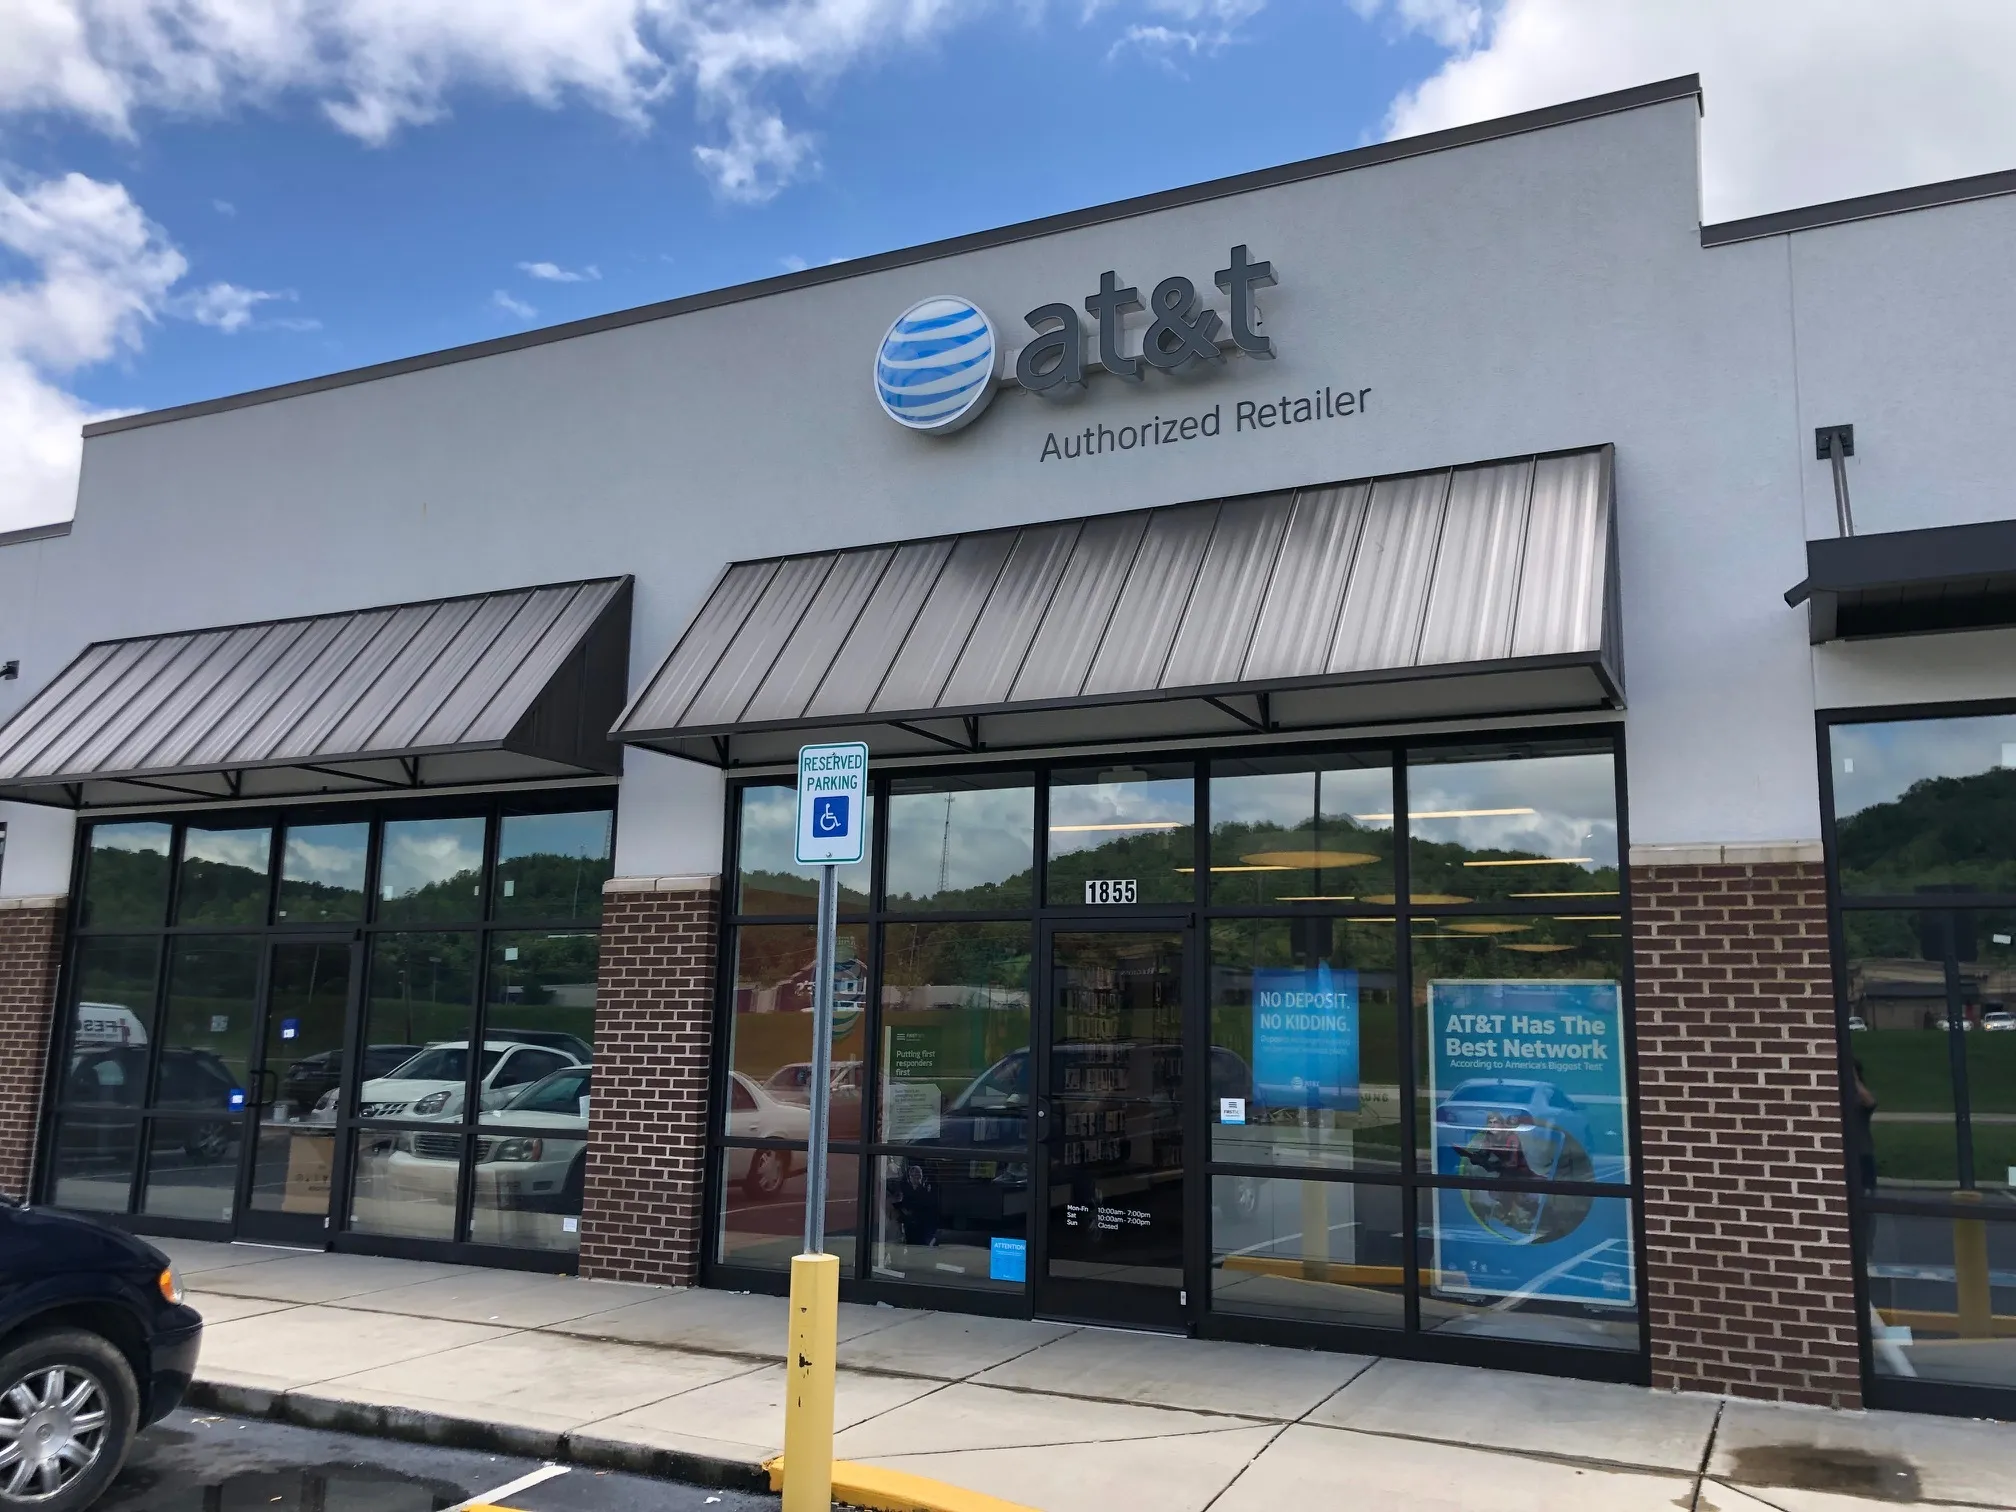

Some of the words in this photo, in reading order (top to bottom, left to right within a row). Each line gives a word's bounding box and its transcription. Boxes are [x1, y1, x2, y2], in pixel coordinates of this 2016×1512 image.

[1015, 244, 1277, 391] at&t
[1040, 404, 1221, 463] Authorized
[1235, 385, 1372, 433] Retailer
[803, 754, 863, 772] RESERVED
[806, 774, 858, 792] PARKING
[1088, 880, 1135, 903] 1855
[1260, 991, 1281, 1008] NO
[1285, 991, 1351, 1010] DEPOSIT.
[1260, 1013, 1281, 1030] NO
[1285, 1013, 1351, 1032] KIDDING.
[1445, 1014, 1506, 1034] AT&T
[1511, 1015, 1556, 1035] Has
[1560, 1015, 1606, 1036] The
[896, 1050, 920, 1060] Putting
[921, 1050, 936, 1058] first
[1446, 1038, 1498, 1058] Best
[1503, 1038, 1608, 1060] Network
[895, 1068, 911, 1076] first
[896, 1060, 933, 1069] responders
[1450, 1059, 1492, 1070] According
[1492, 1060, 1503, 1069] to
[1505, 1060, 1549, 1071] America's
[1549, 1061, 1582, 1073] Biggest
[1066, 1211, 1077, 1219] Sat
[1127, 1217, 1151, 1226] 7:00pm
[1127, 1209, 1151, 1219] 7:00pm
[1097, 1222, 1119, 1230] Closed
[994, 1242, 1026, 1251] ATTENTION
